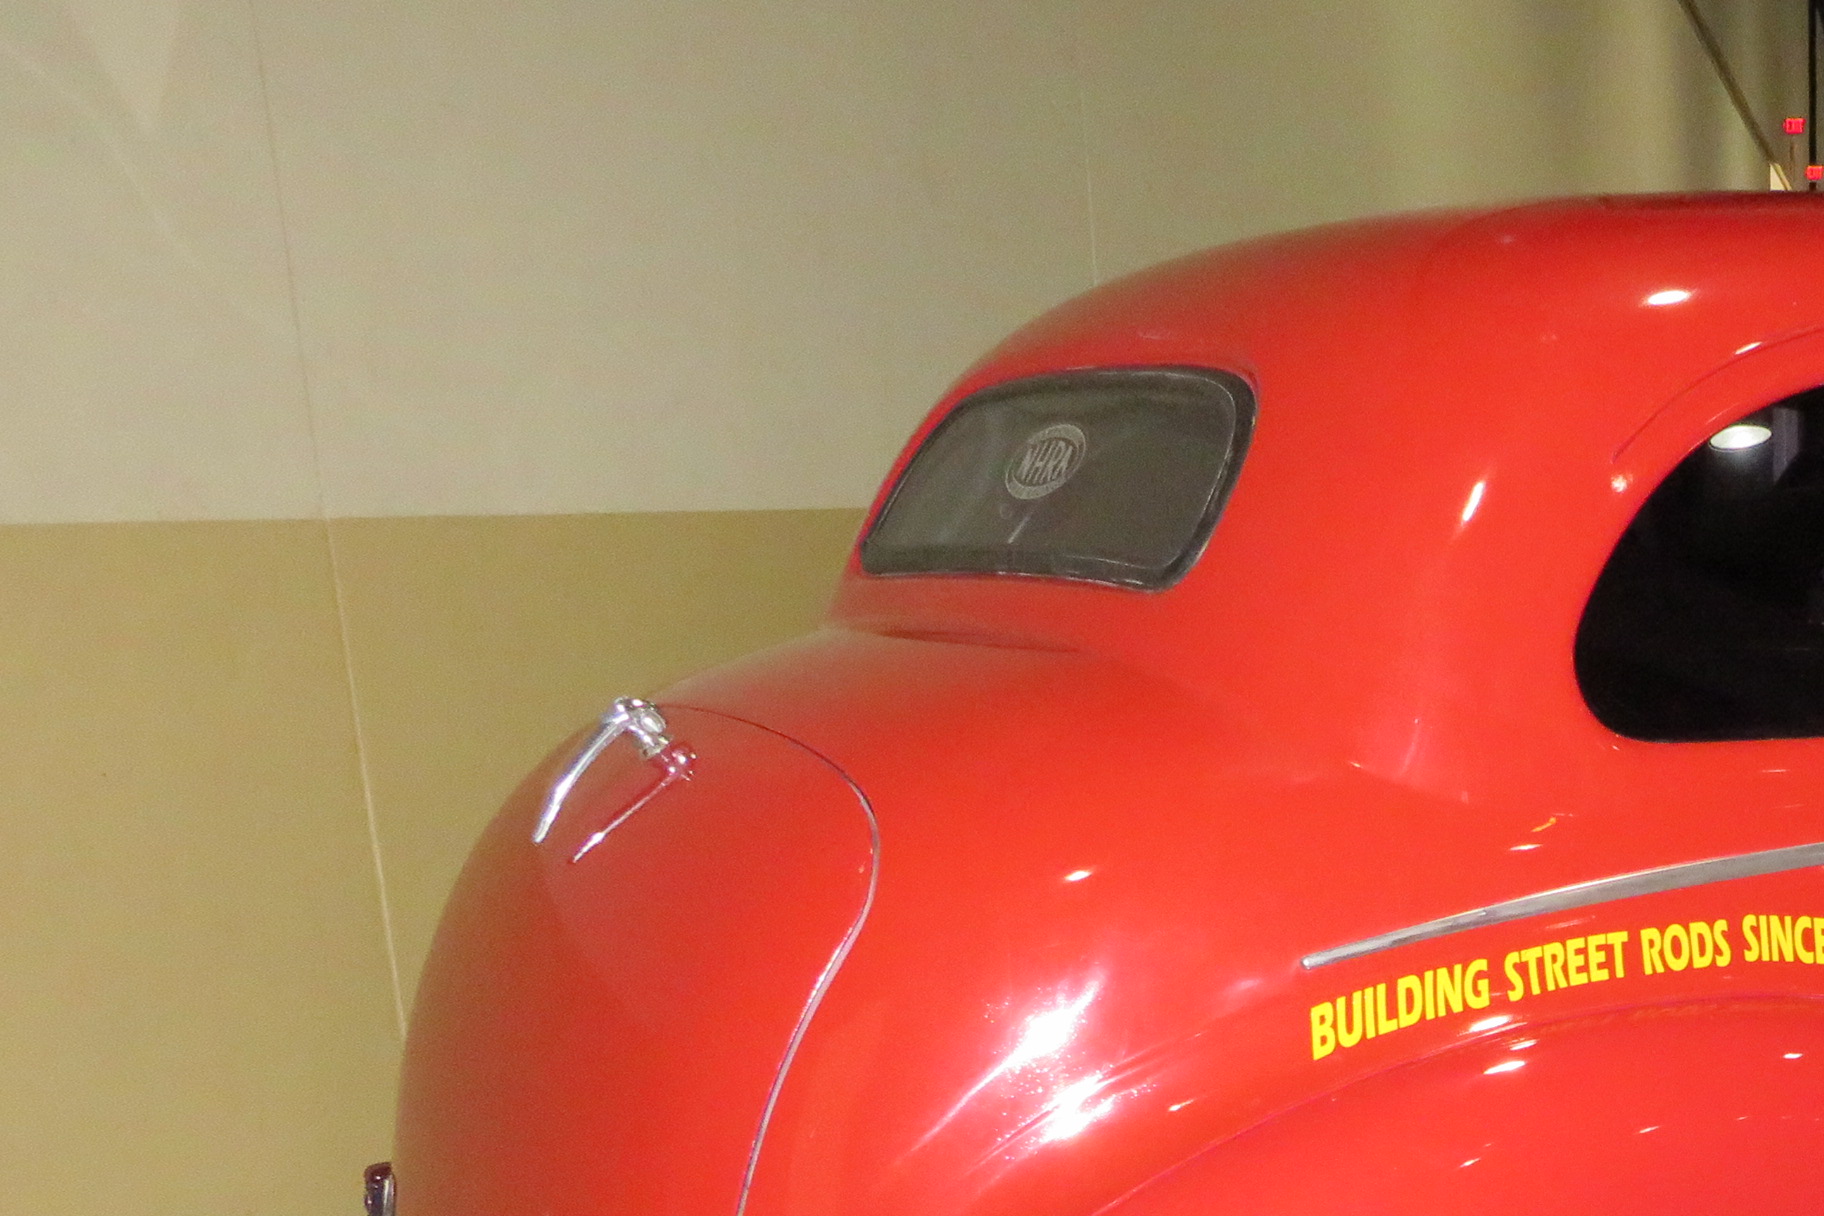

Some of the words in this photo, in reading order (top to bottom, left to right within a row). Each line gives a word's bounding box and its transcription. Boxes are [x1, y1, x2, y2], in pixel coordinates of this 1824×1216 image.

[1016, 440, 1073, 485] NHRA
[1309, 958, 1491, 1061] BUILDING
[1503, 930, 1629, 1002] STREET
[1639, 919, 1732, 976] RODS
